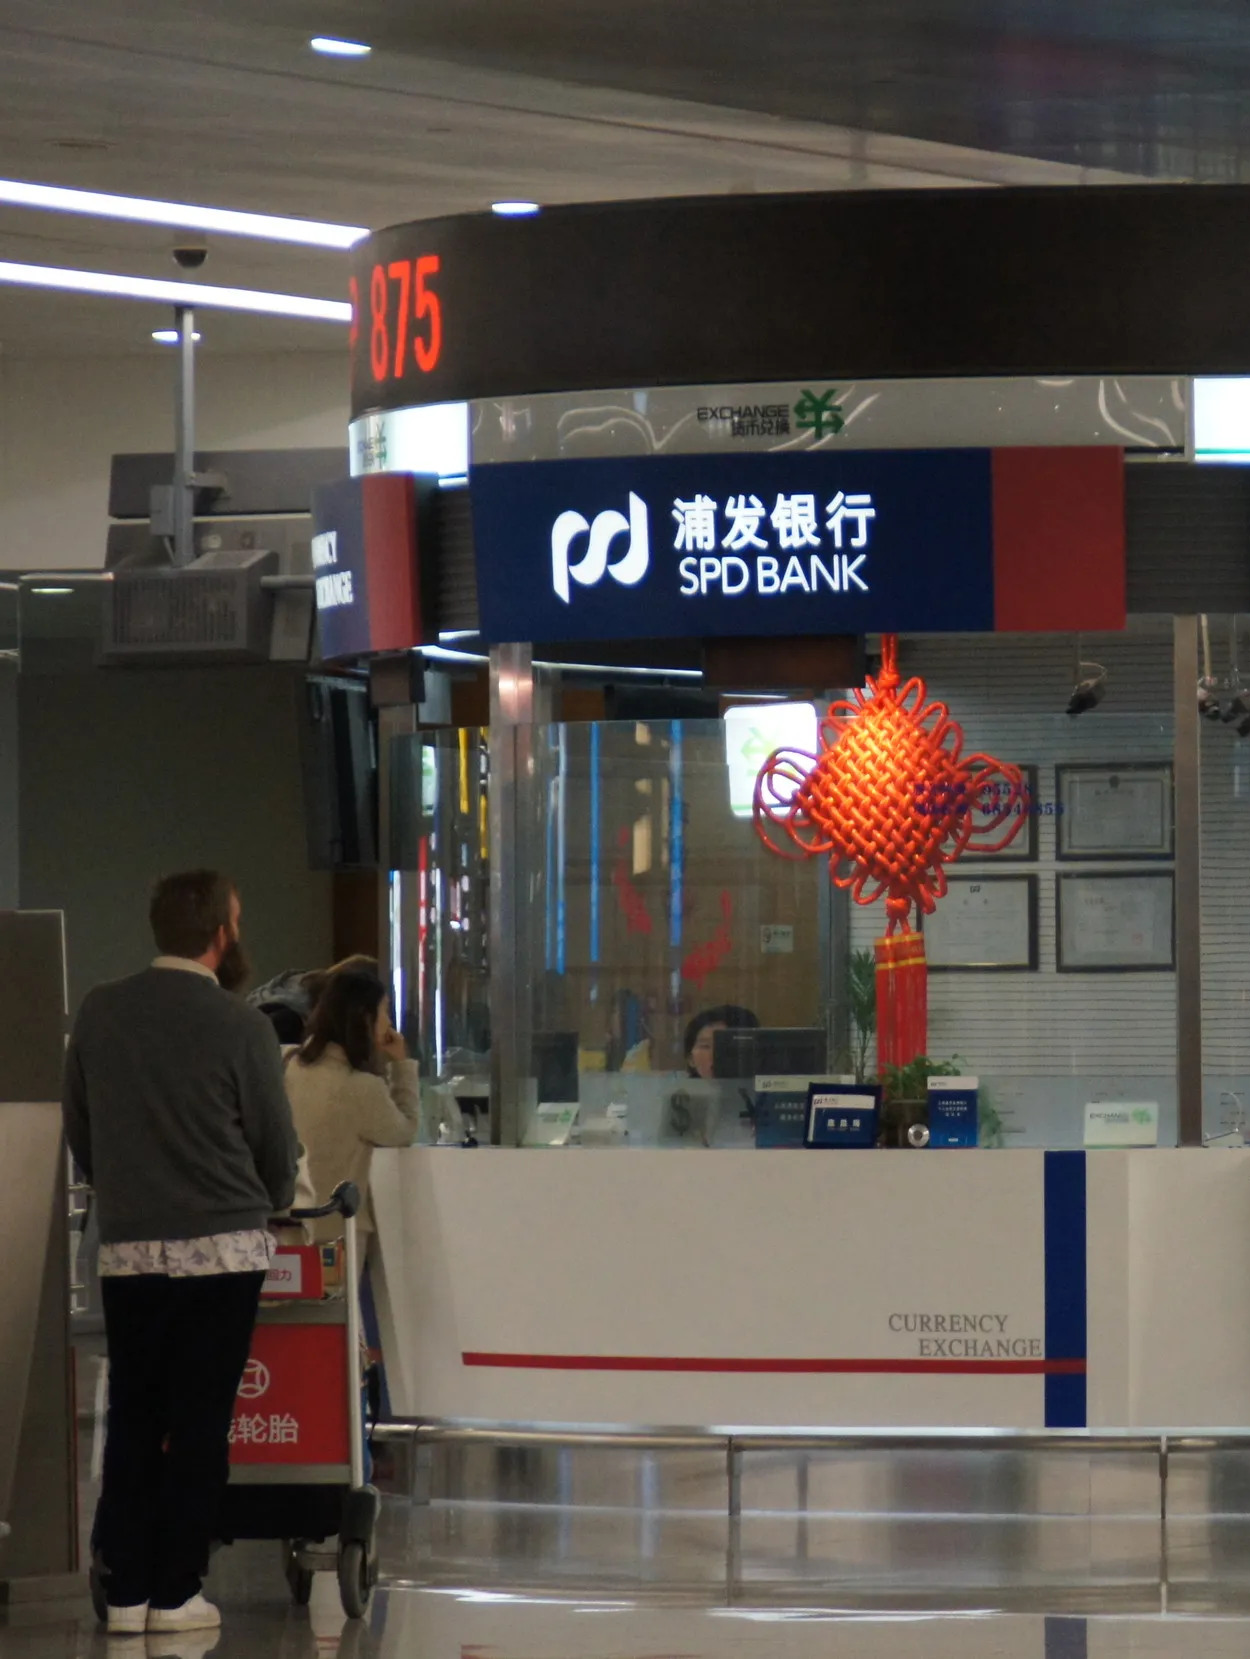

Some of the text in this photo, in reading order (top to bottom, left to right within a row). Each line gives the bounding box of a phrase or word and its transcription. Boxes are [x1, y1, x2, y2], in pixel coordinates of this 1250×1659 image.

[369, 254, 442, 382] 875
[697, 404, 790, 420] EXCHANGE
[671, 490, 876, 551] 浦发银行
[678, 554, 870, 594] SPD BANK
[888, 1313, 1009, 1333] CURRENCY
[918, 1338, 1043, 1357] EXCHANGE
